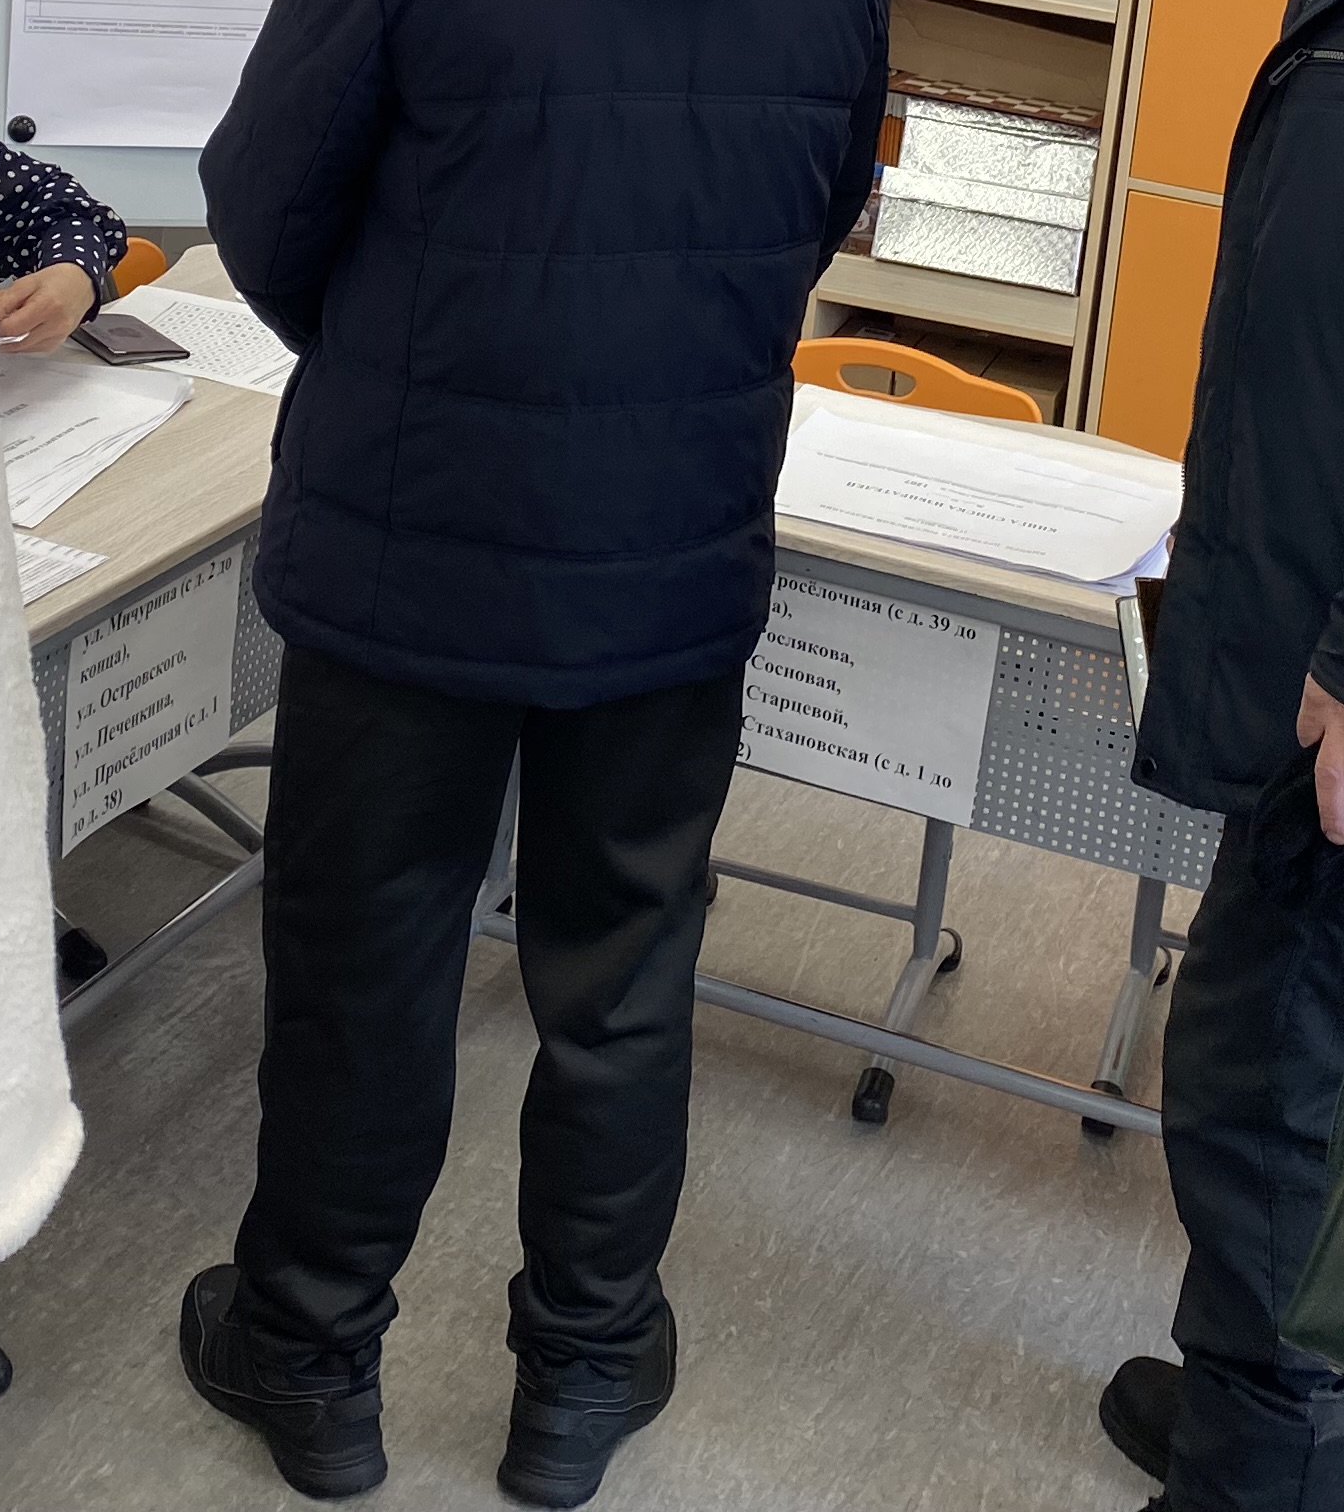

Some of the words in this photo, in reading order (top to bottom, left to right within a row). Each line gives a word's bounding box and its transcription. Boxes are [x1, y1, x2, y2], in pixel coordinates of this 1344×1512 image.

[82, 630, 103, 655] ул.
[107, 583, 177, 634] Мичурина
[208, 562, 215, 580] 2
[217, 556, 232, 577] до
[774, 573, 882, 614] росёлочная
[887, 602, 903, 620] (с
[907, 612, 924, 626] д.
[928, 614, 950, 632] 39
[954, 624, 977, 641] до
[80, 643, 130, 684] конца),
[750, 654, 842, 695] Сосновая,
[762, 631, 854, 668] ослякова,
[76, 700, 96, 729] ул.
[100, 648, 187, 709] Островского,
[746, 684, 849, 729] Старцевой,
[72, 780, 91, 808] ул.
[94, 720, 181, 787] Просёлочная
[74, 741, 93, 769] ул.
[97, 691, 174, 749] Печенкина,
[741, 714, 869, 765] Стахановская
[874, 752, 891, 772] (с
[929, 772, 952, 789] до
[101, 787, 123, 817] 38)
